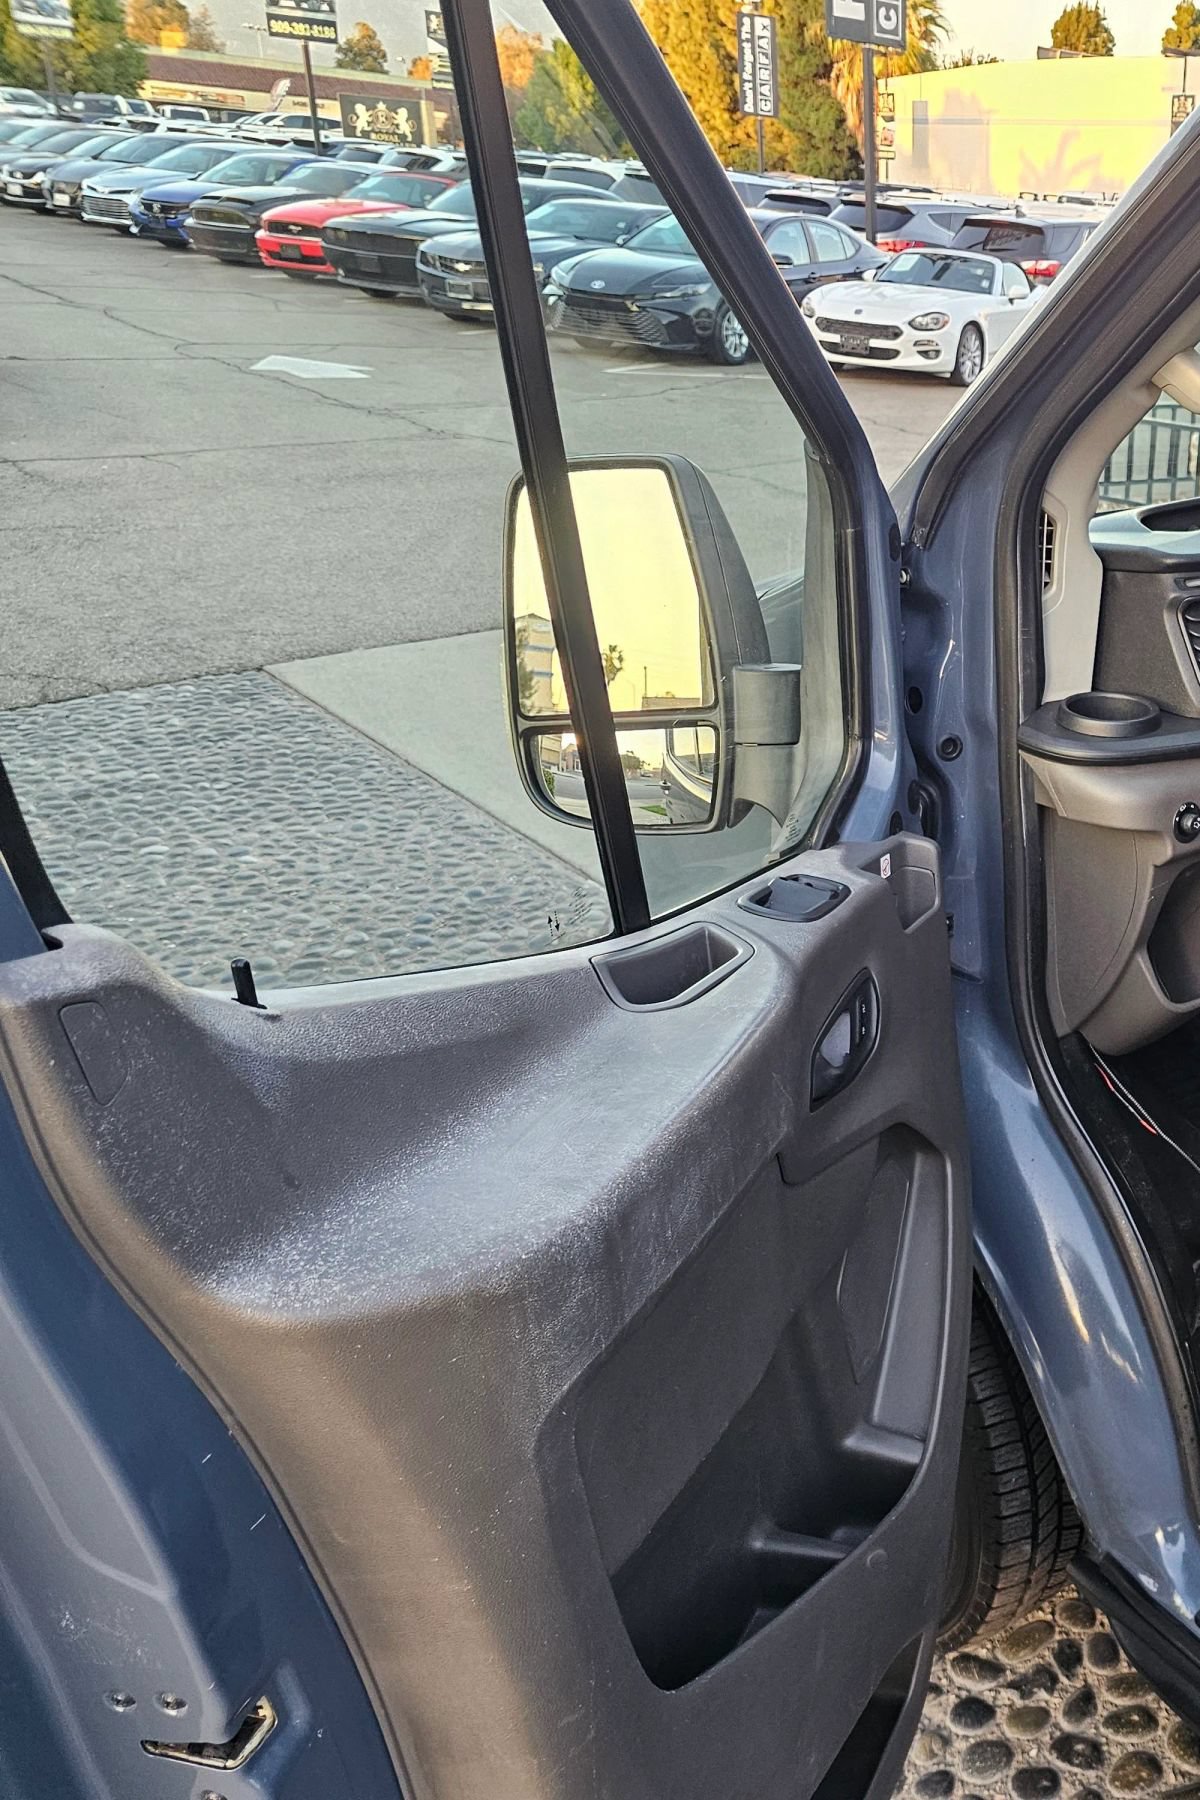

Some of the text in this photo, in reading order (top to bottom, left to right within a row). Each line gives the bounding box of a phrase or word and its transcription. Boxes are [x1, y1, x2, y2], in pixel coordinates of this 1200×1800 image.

[741, 16, 754, 113] Don't Forget The
[757, 23, 771, 113] CARFAX
[370, 133, 400, 143] ROYAL
